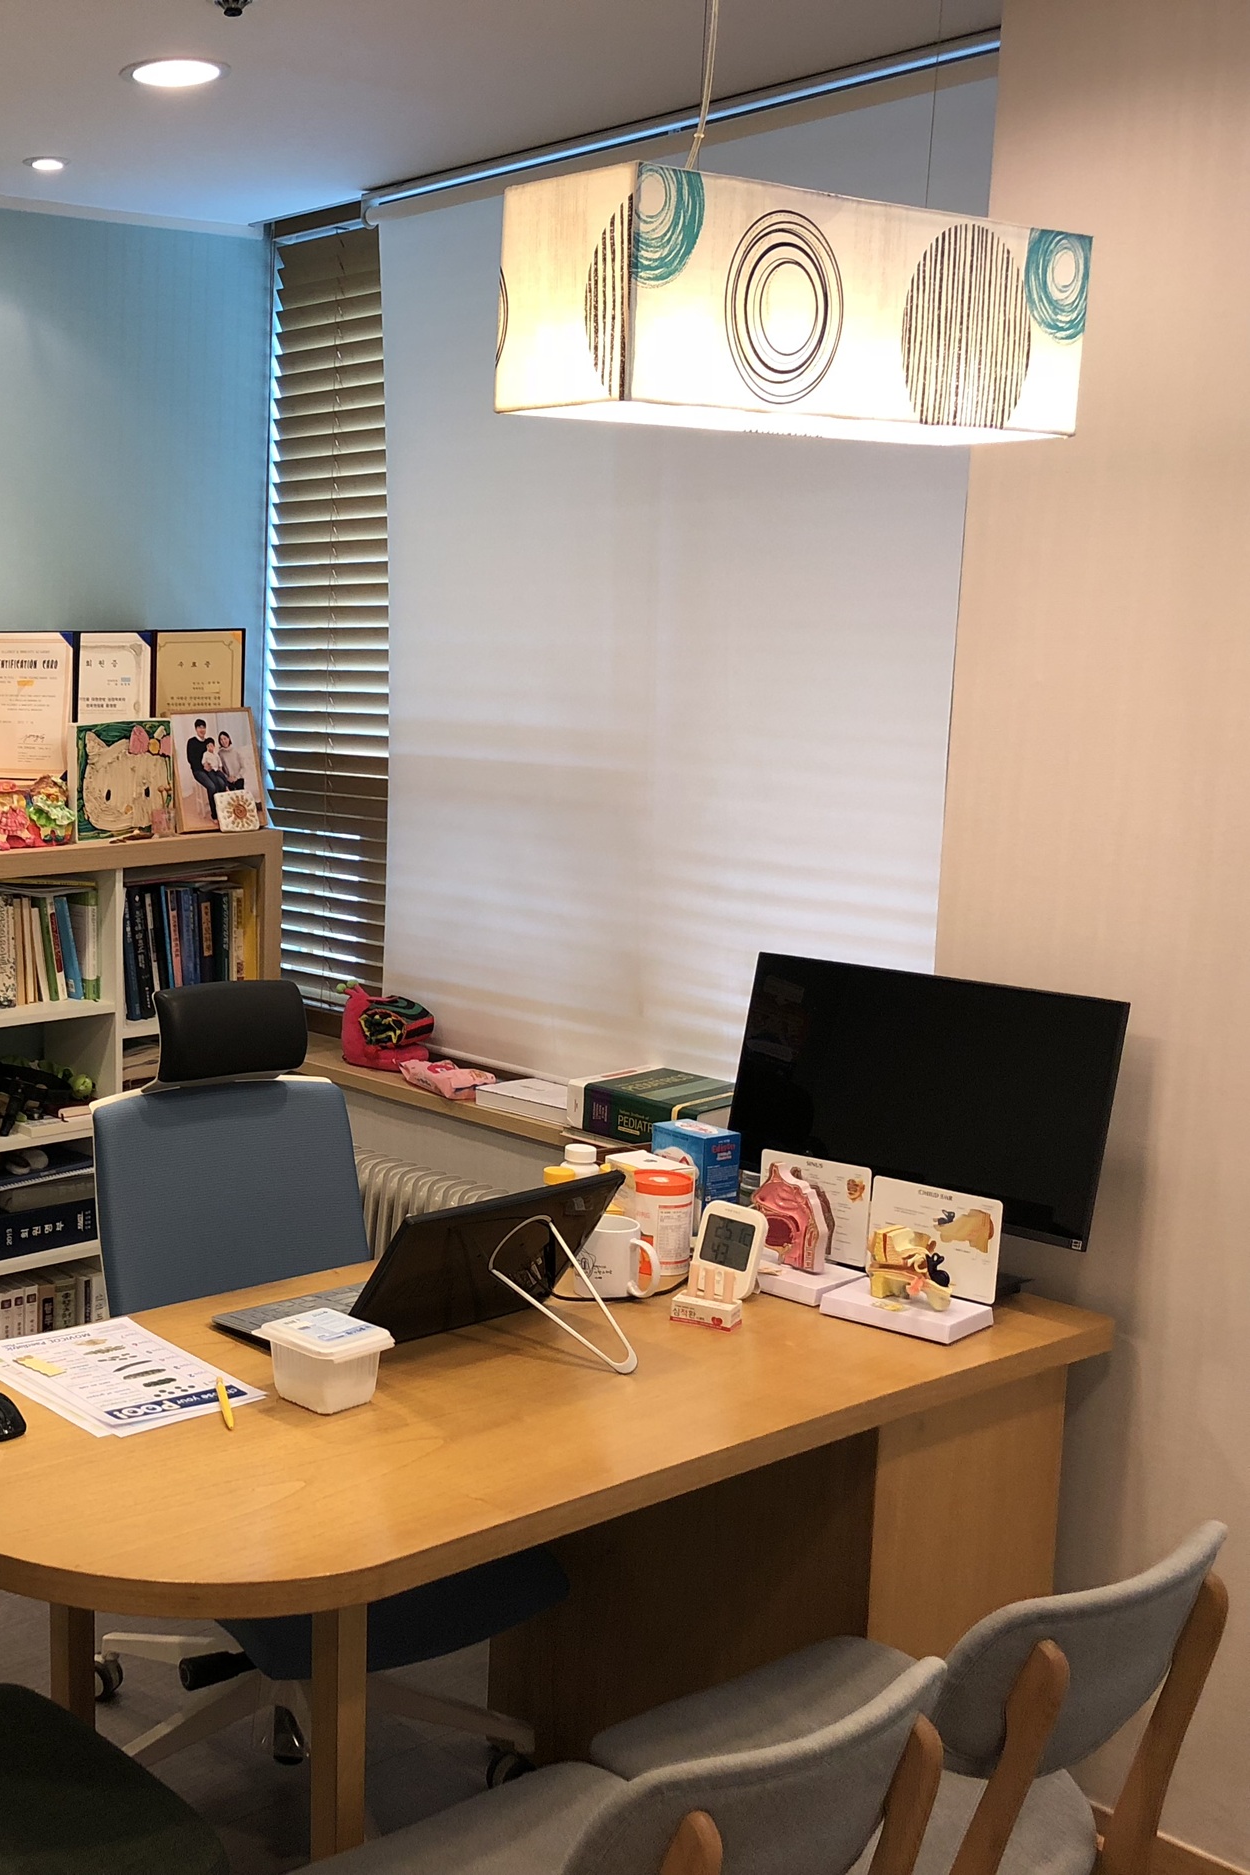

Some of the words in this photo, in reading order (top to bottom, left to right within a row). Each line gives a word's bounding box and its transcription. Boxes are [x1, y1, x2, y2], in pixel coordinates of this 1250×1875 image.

[42, 660, 58, 669] CARD
[618, 1115, 653, 1133] PEDIATR
[806, 1160, 824, 1169] SINUS
[918, 1189, 939, 1200] CHILD
[672, 1307, 696, 1319] 심적환
[50, 1332, 91, 1344] MOVICOL
[6, 1342, 46, 1351] Paediatric
[200, 1388, 238, 1399] chose
[176, 1394, 200, 1405] your
[113, 1400, 181, 1419] POO!
